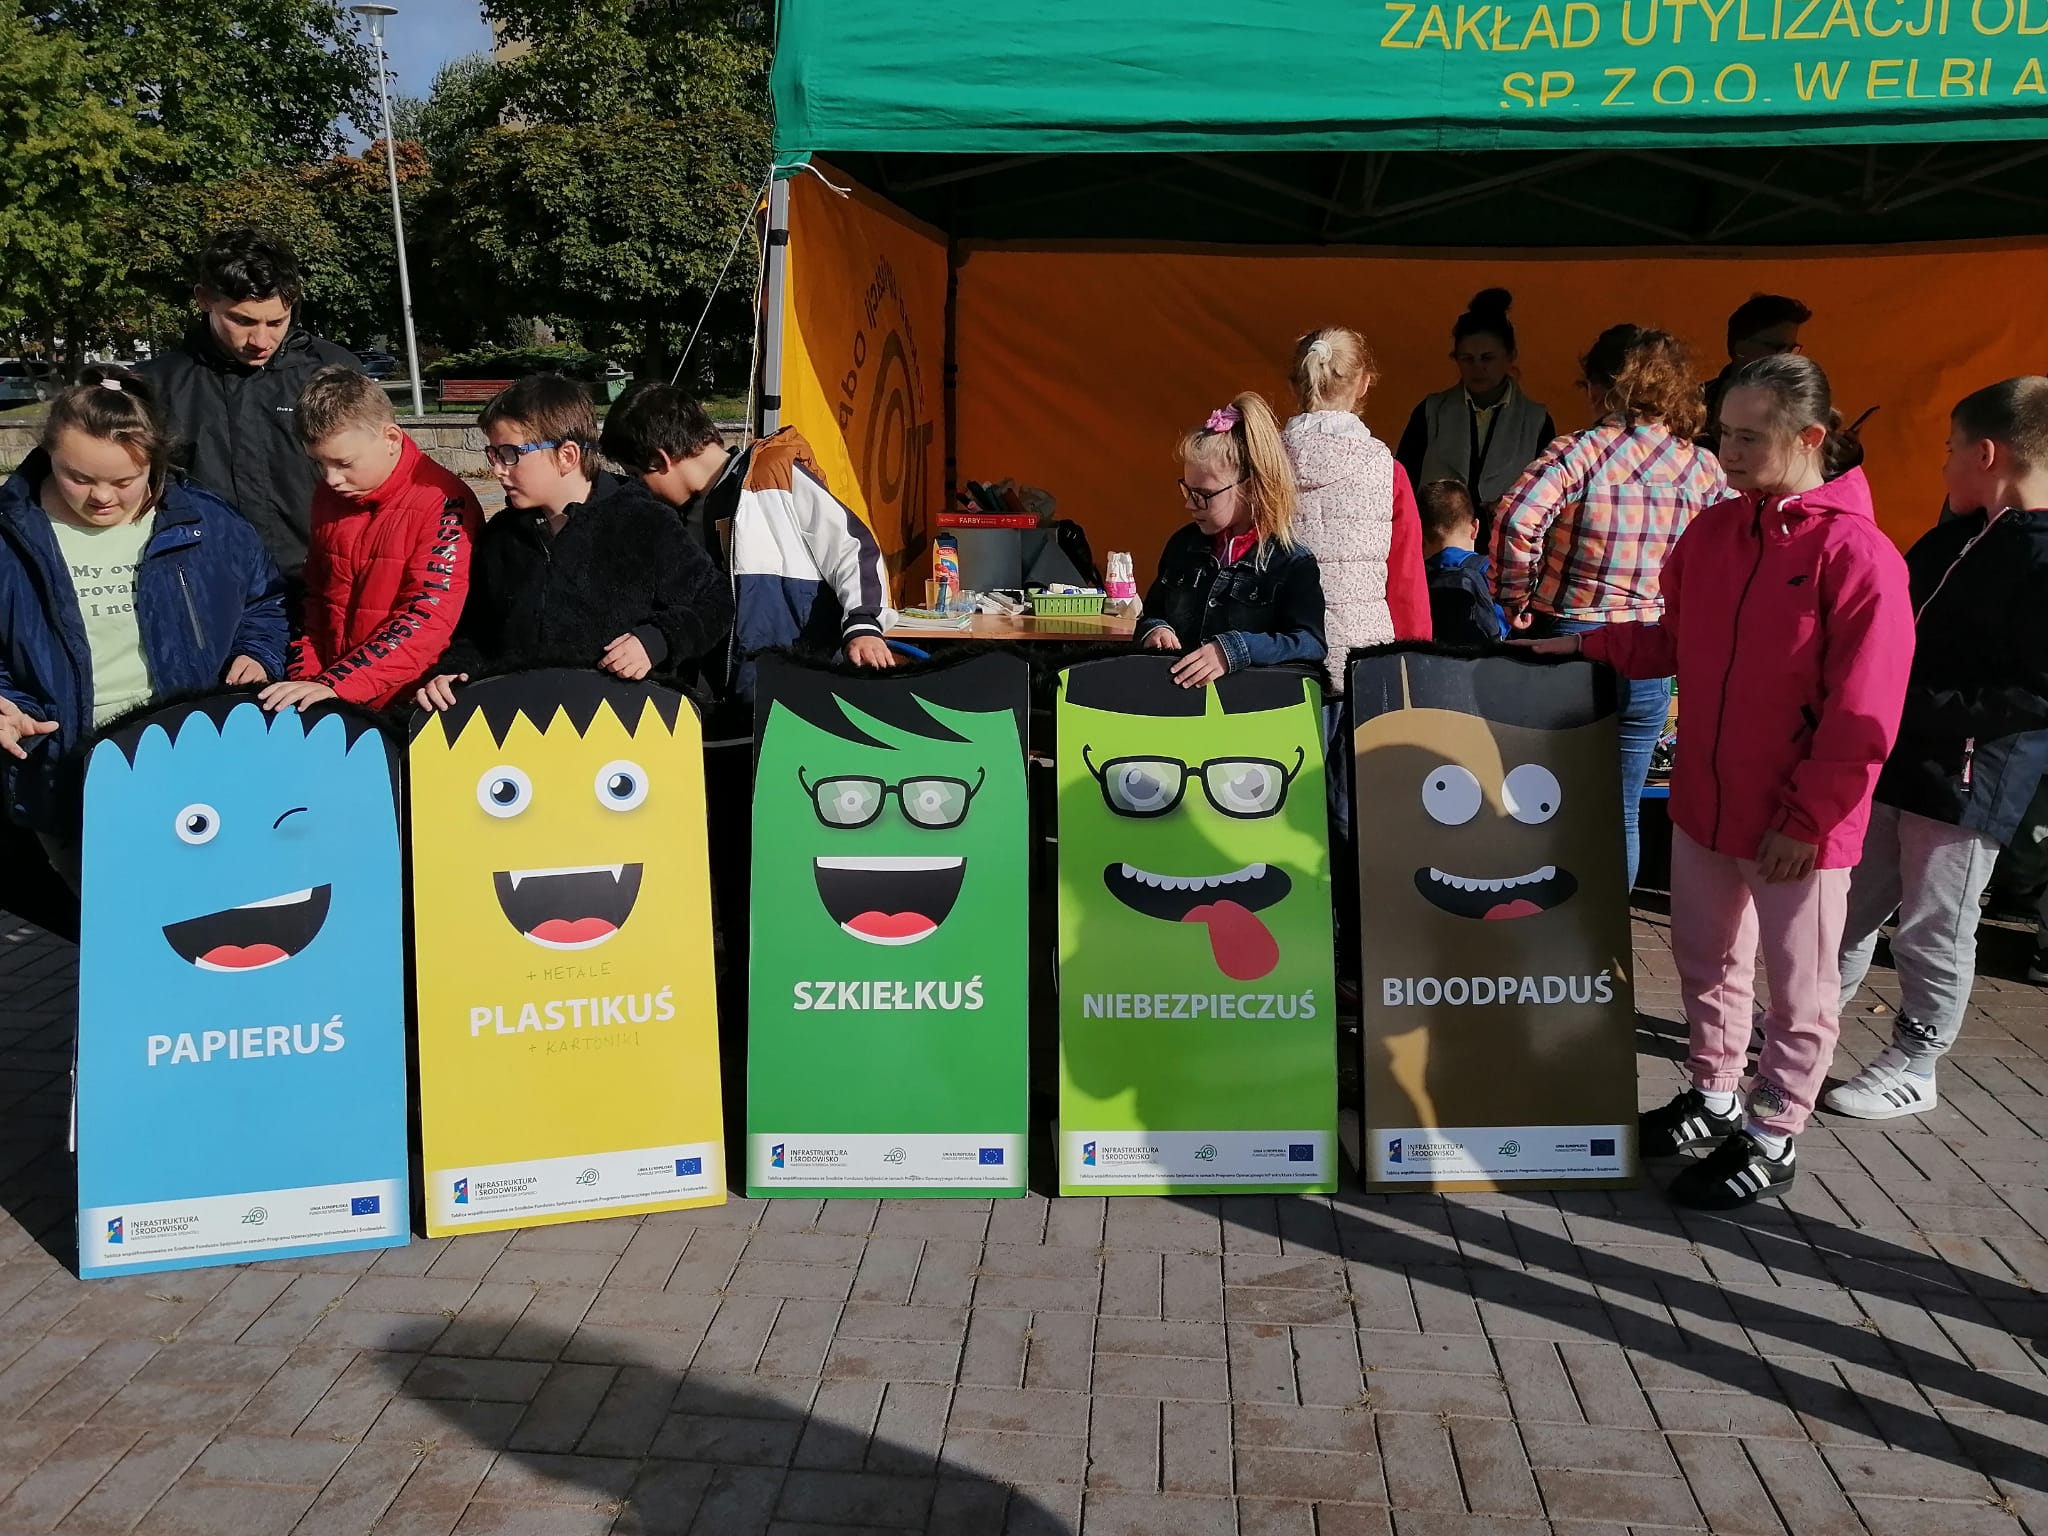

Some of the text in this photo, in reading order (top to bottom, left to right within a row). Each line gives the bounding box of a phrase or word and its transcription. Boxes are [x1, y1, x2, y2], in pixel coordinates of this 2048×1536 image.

[1380, 2, 1600, 50] ZAKŁAD
[1621, 0, 1950, 45] UTYLIZACJI
[1601, 68, 1636, 106] Z
[1794, 61, 1850, 100] W
[72, 563, 140, 579] My ow
[77, 580, 137, 598] roval
[91, 604, 100, 616] I
[544, 962, 612, 981] METALE
[1383, 969, 1613, 1006] BIOODPADUŚ
[793, 975, 984, 1010] SZKIEŁKUŚ
[1083, 989, 1316, 1019] NIEBEZPIECZUŚ
[470, 985, 676, 1037] PLASTIKUŚ
[147, 1014, 346, 1067] PAPIERUŚ
